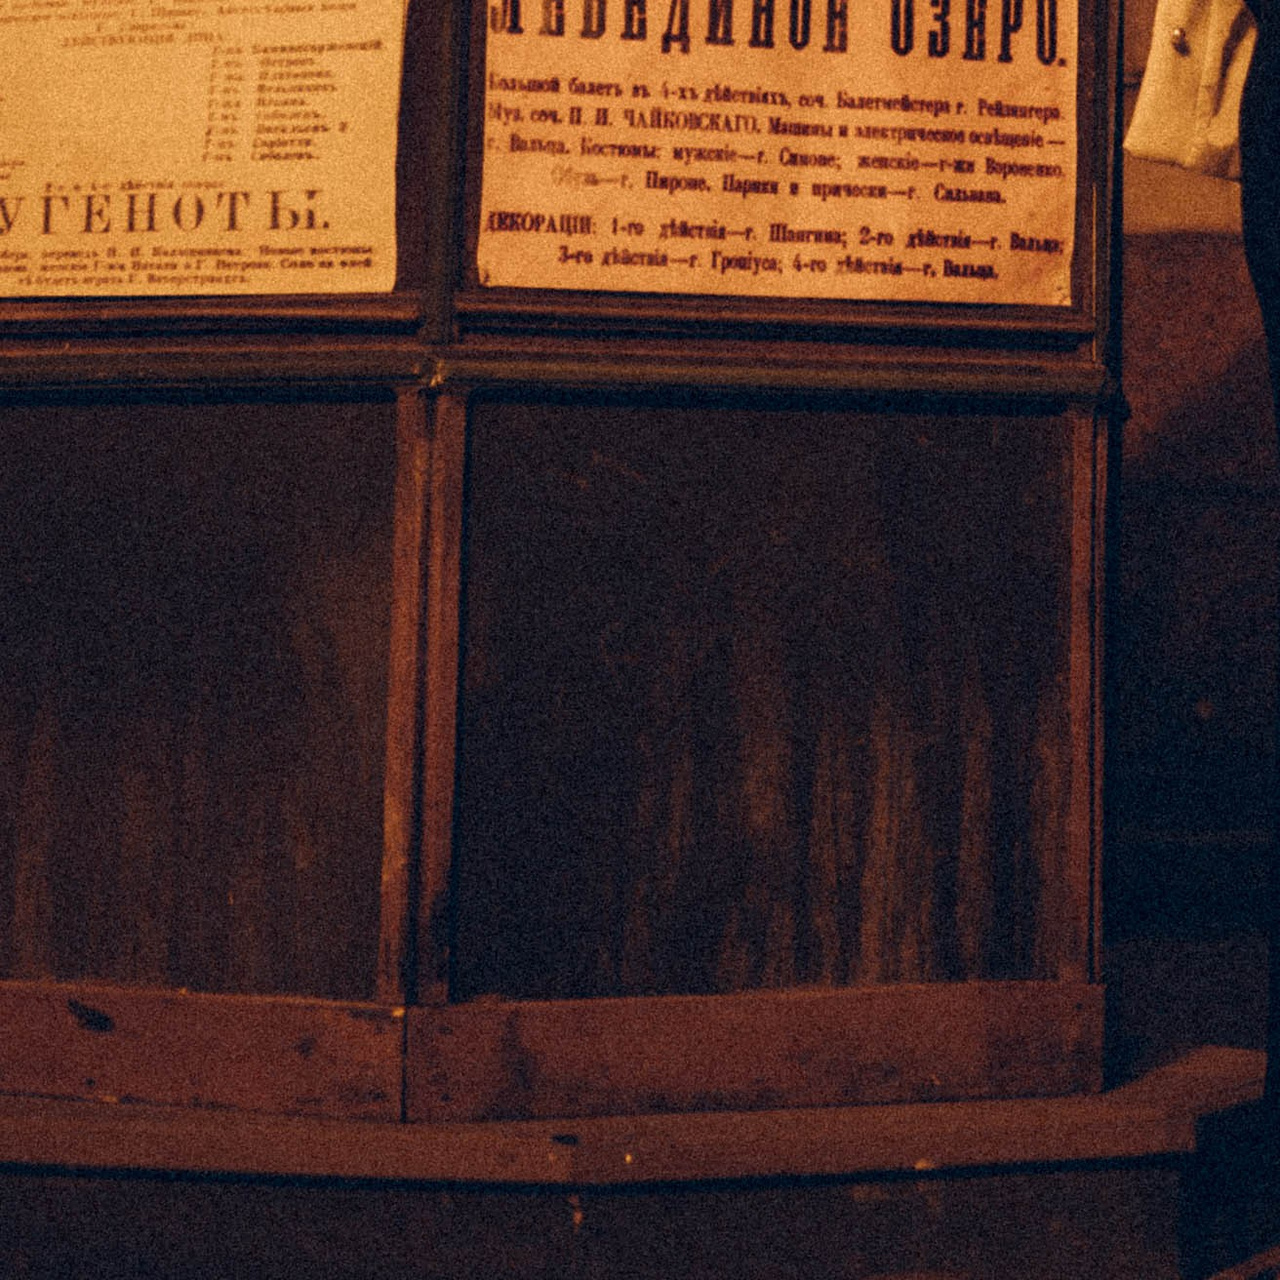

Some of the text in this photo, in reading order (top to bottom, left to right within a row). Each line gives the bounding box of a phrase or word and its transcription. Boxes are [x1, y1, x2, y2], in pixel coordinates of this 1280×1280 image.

[568, 77, 622, 96] балетъ
[632, 84, 649, 97] въ
[836, 90, 950, 117] Балетмейстера
[956, 102, 964, 114] г.
[568, 106, 582, 124] П.
[594, 107, 608, 126] И.
[623, 106, 761, 133] ЧАЙКОВСКАГО.
[768, 116, 832, 137] Машины
[839, 126, 847, 136] и
[855, 125, 965, 144] электрическое
[509, 133, 570, 155] Вальца.
[722, 173, 779, 198] Парики
[790, 182, 798, 195] и
[484, 210, 591, 236] ДЕКОРАЦІИ:
[611, 216, 644, 236] 1-го
[858, 225, 894, 246] 2-го
[558, 244, 593, 264] 3-го
